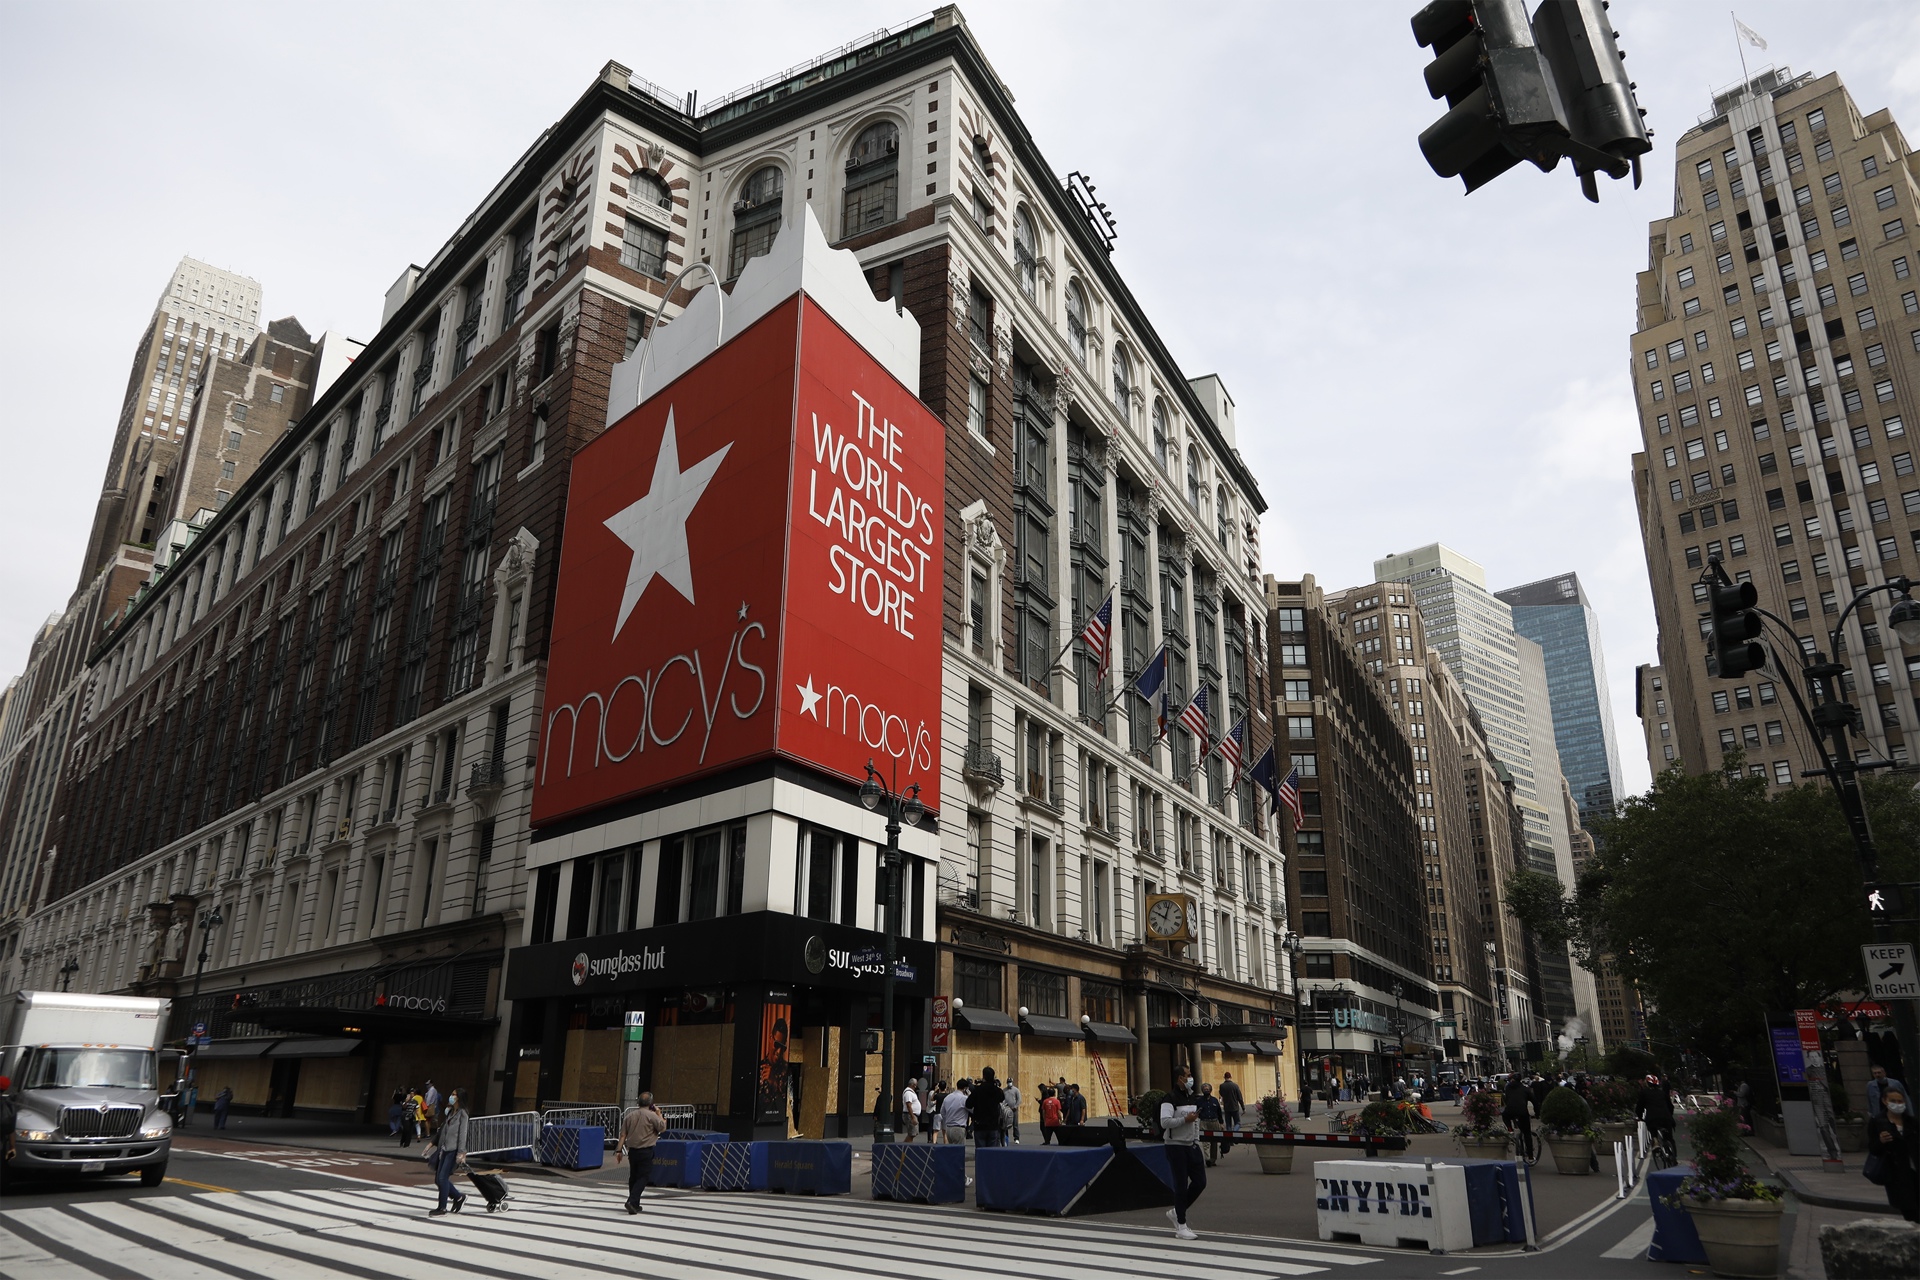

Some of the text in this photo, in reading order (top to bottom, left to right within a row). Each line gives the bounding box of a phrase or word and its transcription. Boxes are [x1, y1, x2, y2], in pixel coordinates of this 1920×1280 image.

[852, 390, 903, 472] THE
[811, 412, 933, 545] WORLD'S
[809, 469, 930, 592] LARGEST
[828, 545, 915, 640] STORE
[590, 945, 666, 981] sunglass hut
[851, 954, 865, 963] West
[1870, 948, 1905, 960] KEEP
[895, 968, 914, 980] Broadway
[1875, 983, 1916, 995] RIGHT
[388, 994, 446, 1015] macy's
[774, 1160, 815, 1171] Herald Square
[1329, 1179, 1420, 1216] NYPD
